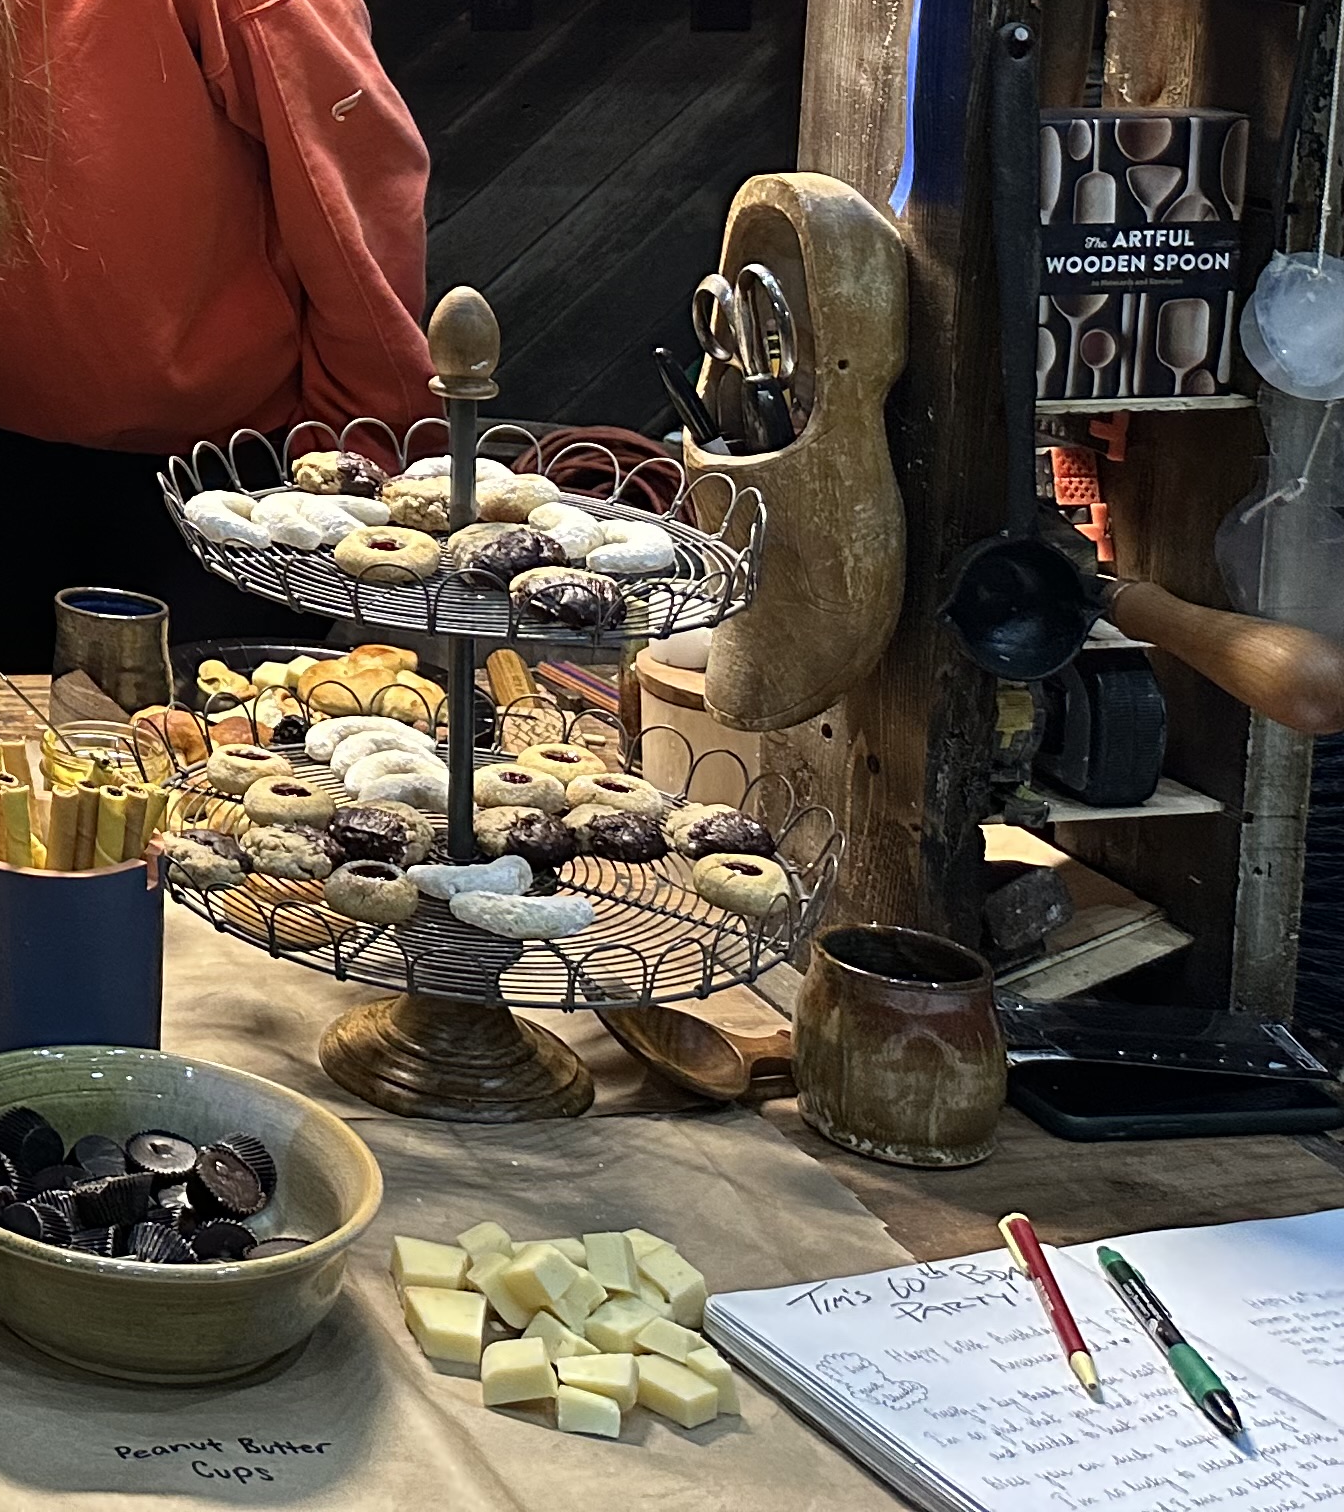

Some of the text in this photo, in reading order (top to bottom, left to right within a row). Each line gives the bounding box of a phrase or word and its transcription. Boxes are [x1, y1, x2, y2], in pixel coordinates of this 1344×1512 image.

[1084, 228, 1196, 250] The ARTFUL
[1045, 252, 1231, 275] WOODEN SPOON
[113, 1436, 333, 1463] Peanut Butter
[191, 1459, 277, 1484] Cups
